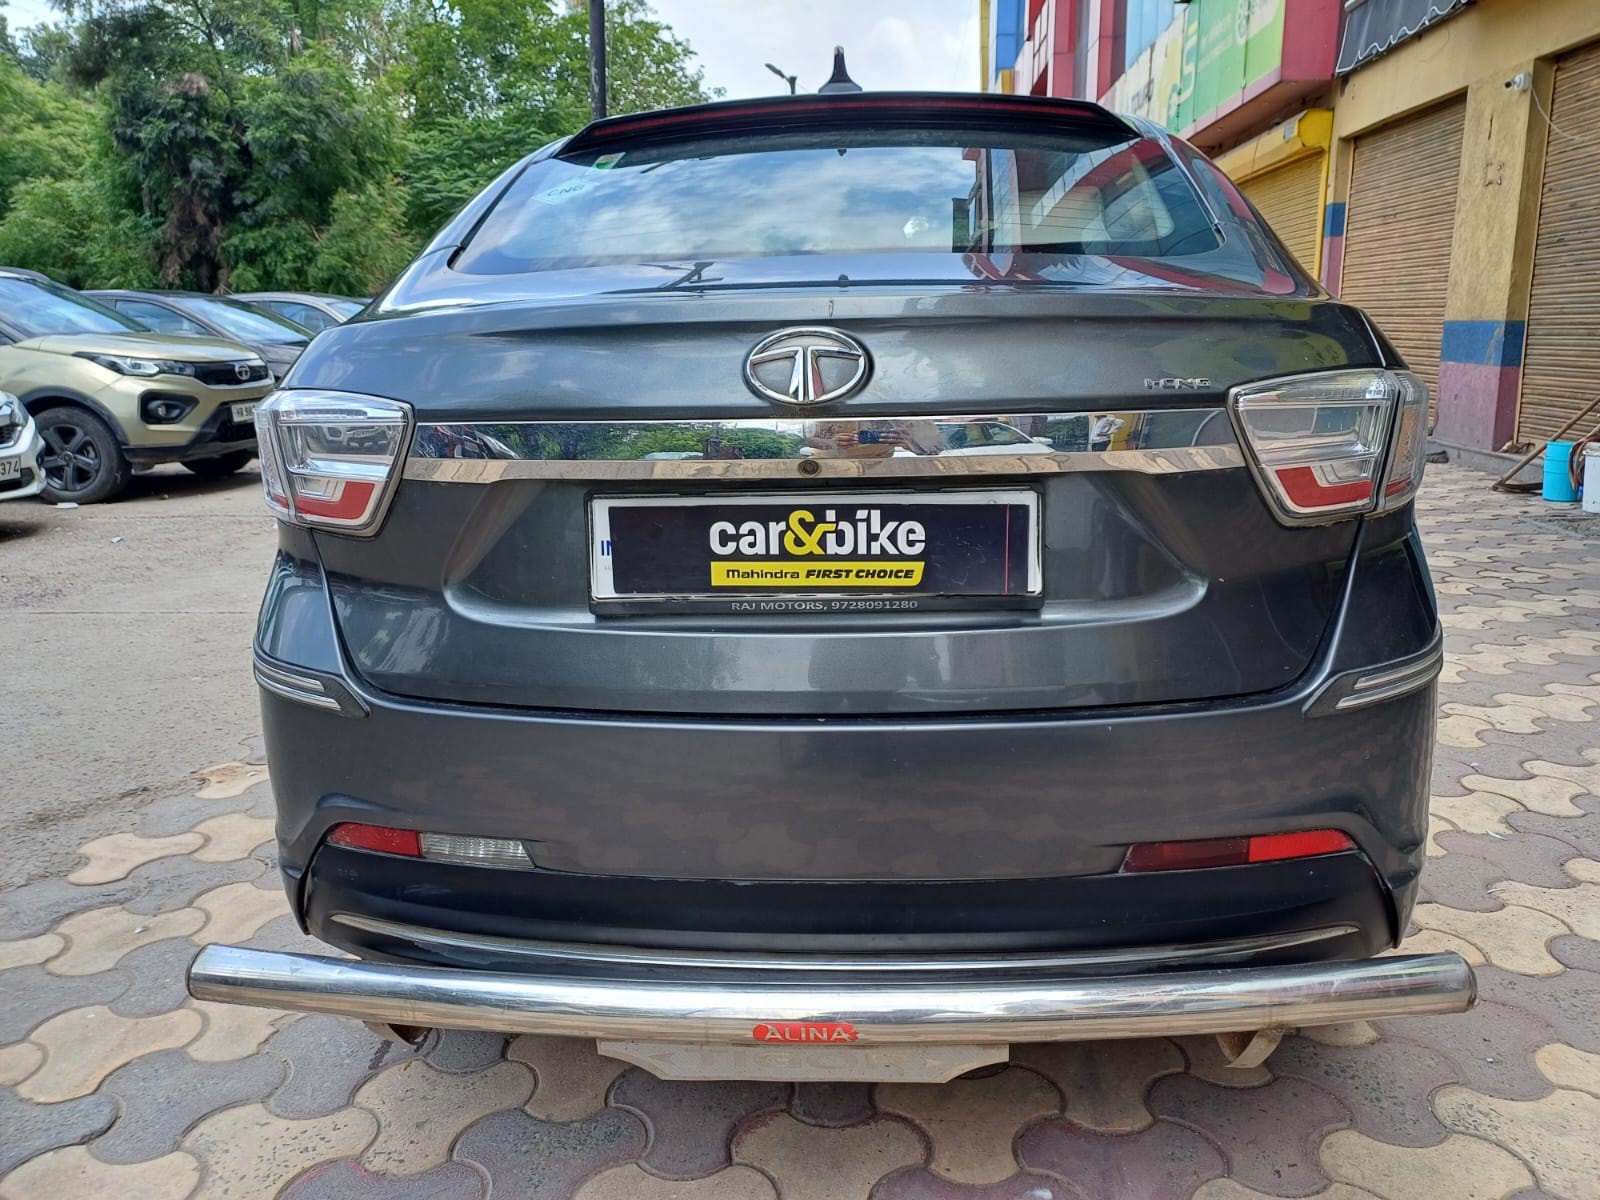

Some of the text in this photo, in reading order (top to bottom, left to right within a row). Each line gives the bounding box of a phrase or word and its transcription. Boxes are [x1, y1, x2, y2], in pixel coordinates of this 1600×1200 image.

[709, 509, 926, 556] car&bike
[726, 568, 915, 580] Mahindra FIRST CHOICE
[731, 600, 919, 611] RAJ MOTORS, 9728091280
[763, 1025, 852, 1042] ALINA
